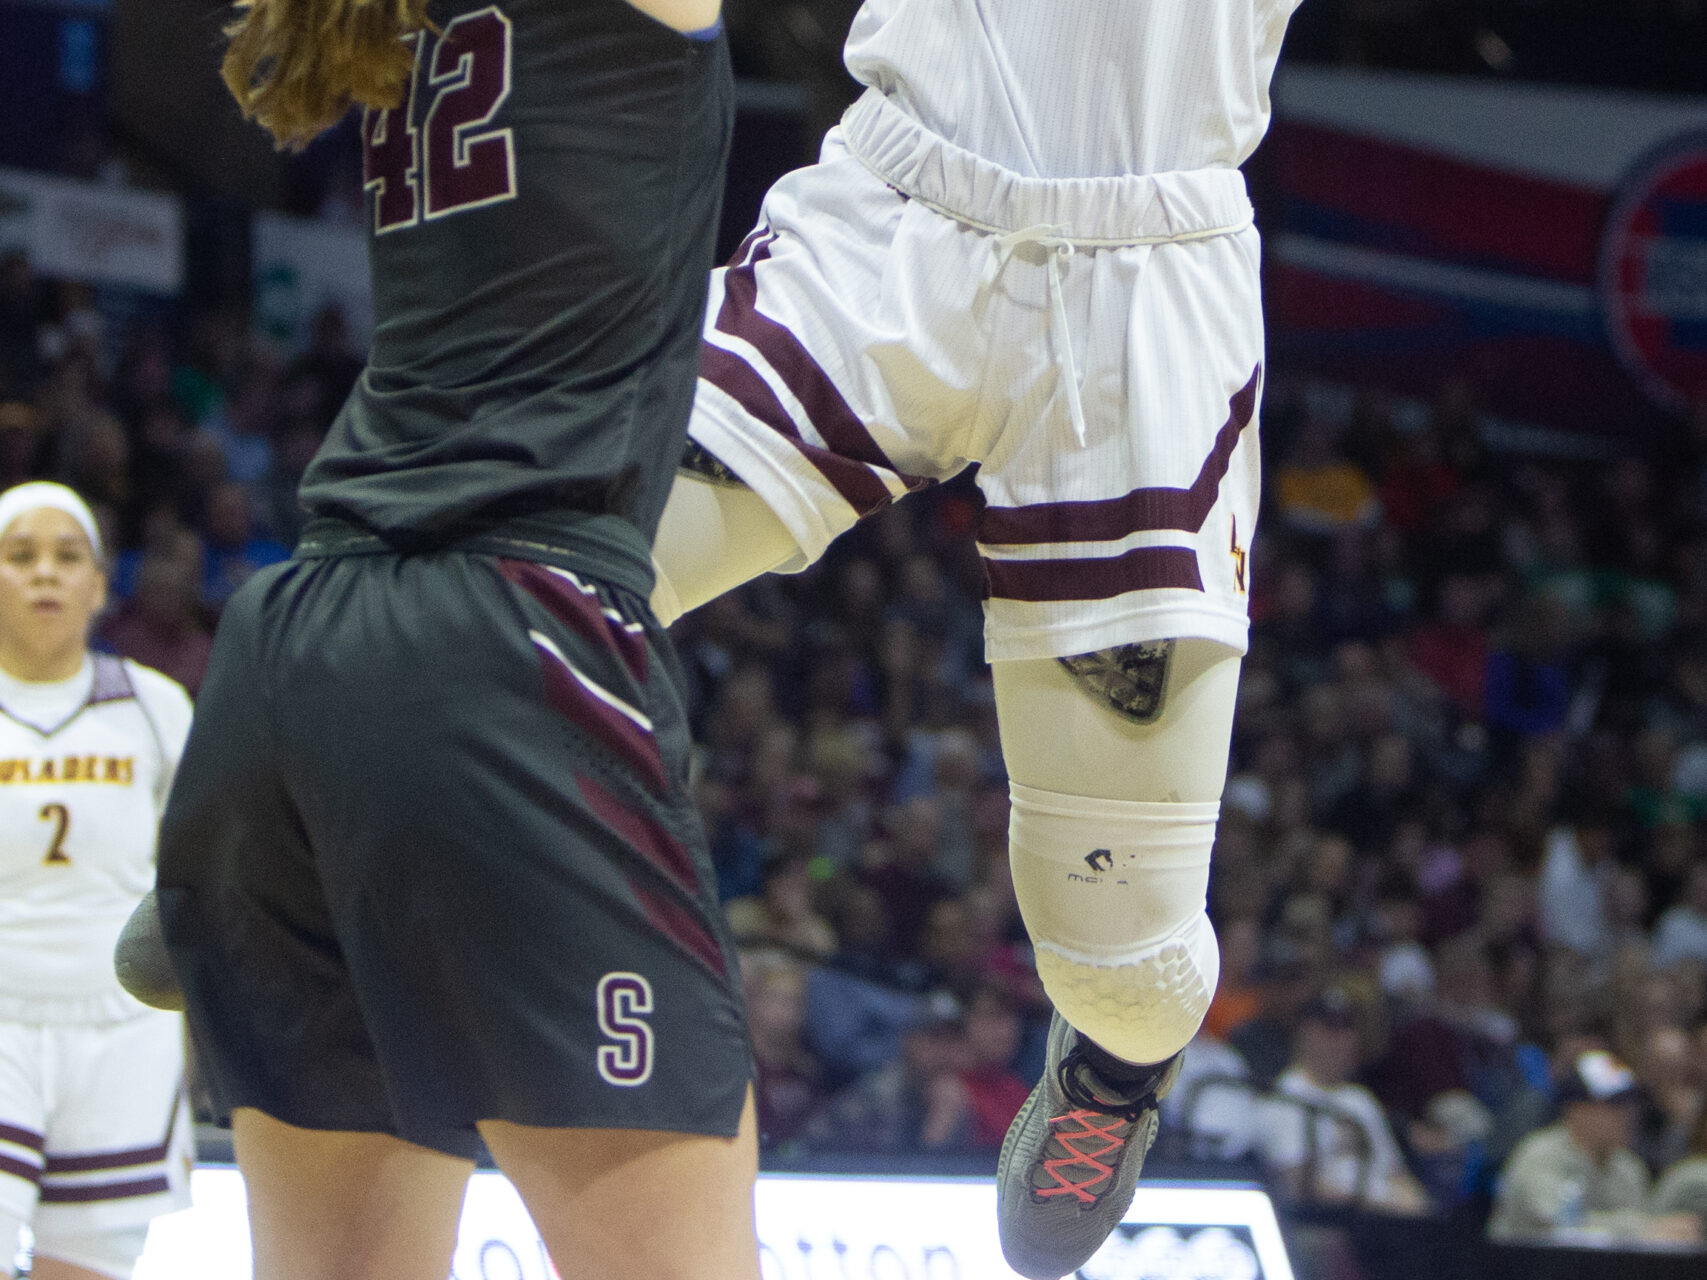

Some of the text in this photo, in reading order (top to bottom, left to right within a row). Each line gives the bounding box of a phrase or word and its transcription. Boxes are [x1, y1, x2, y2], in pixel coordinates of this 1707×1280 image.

[361, 4, 518, 236] 42
[38, 803, 71, 866] 2
[597, 971, 654, 1087] S
